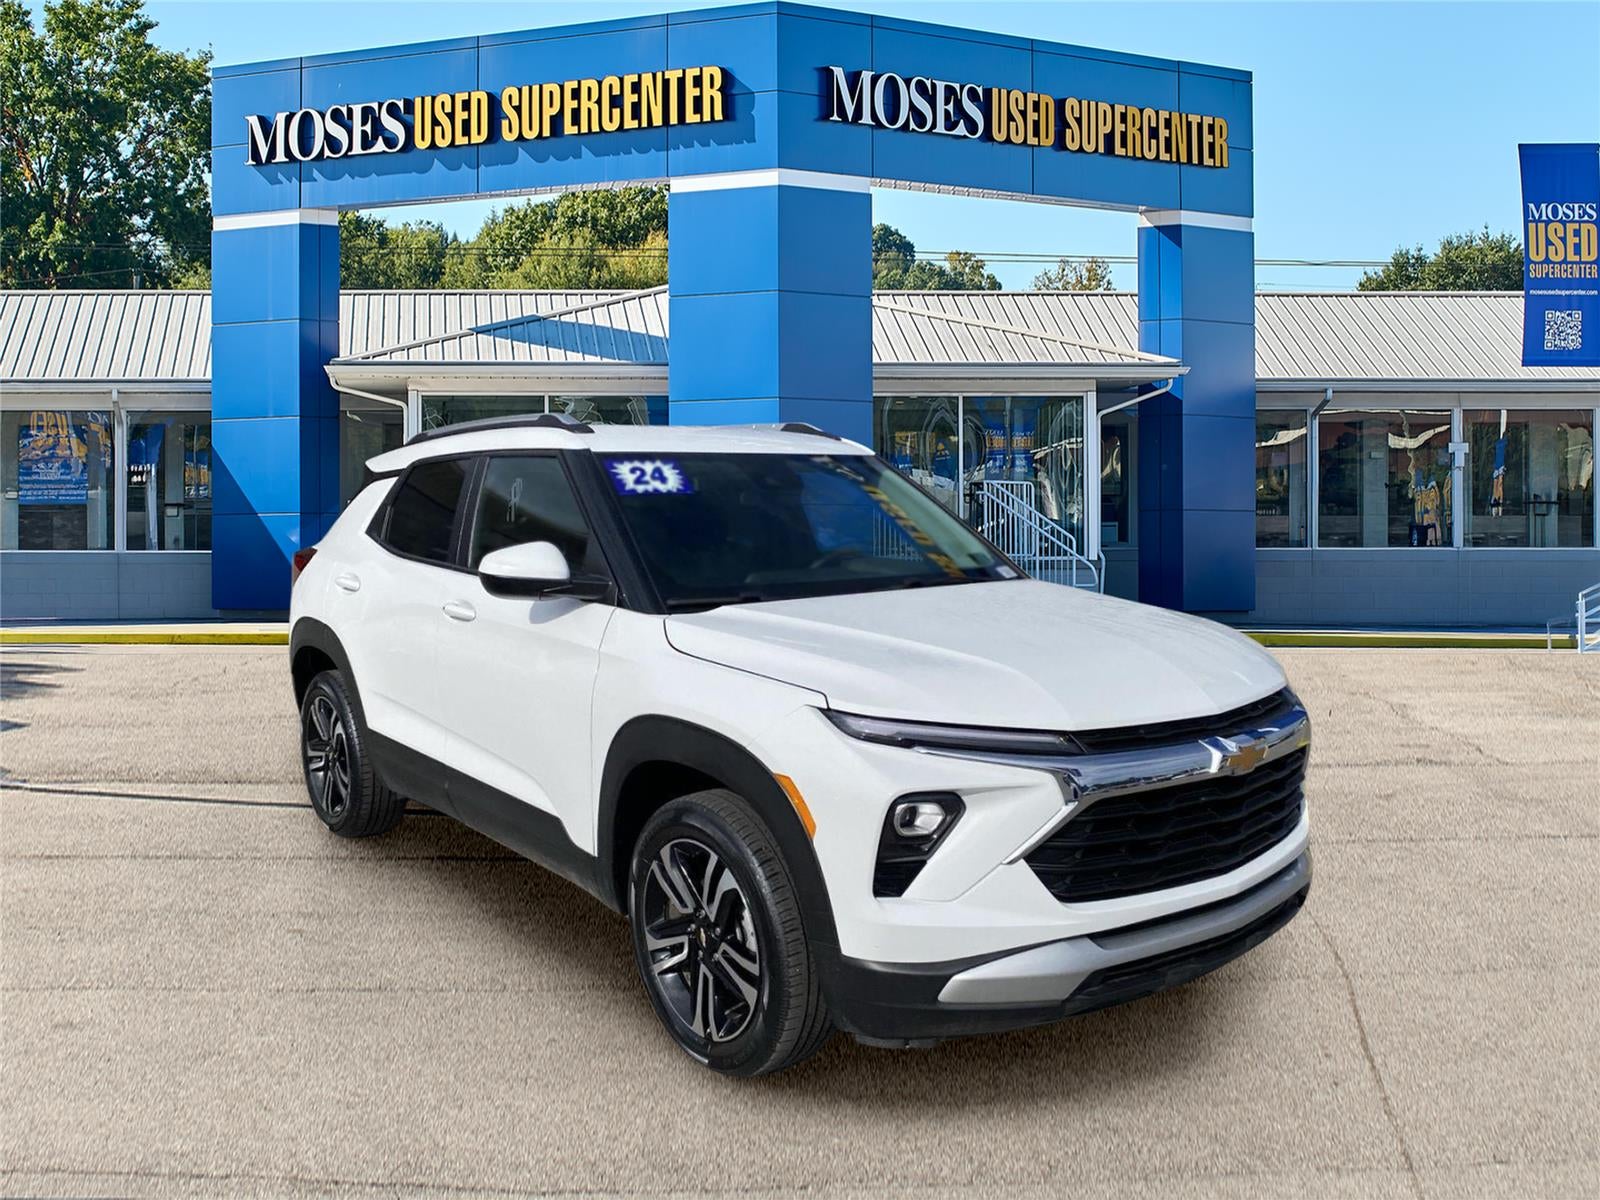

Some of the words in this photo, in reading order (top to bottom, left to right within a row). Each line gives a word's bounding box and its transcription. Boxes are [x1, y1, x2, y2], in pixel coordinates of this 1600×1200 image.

[244, 99, 409, 167] MOSES
[413, 91, 489, 150] USED
[501, 65, 724, 143] SUPERCENTER
[828, 65, 985, 140] MOSES
[991, 87, 1055, 147] USED
[1065, 96, 1229, 168] SUPERCENTER
[1528, 203, 1597, 221] MOSES
[1529, 223, 1597, 262] USED
[1529, 263, 1598, 279] SUPERCENTER
[628, 465, 669, 486] 24
